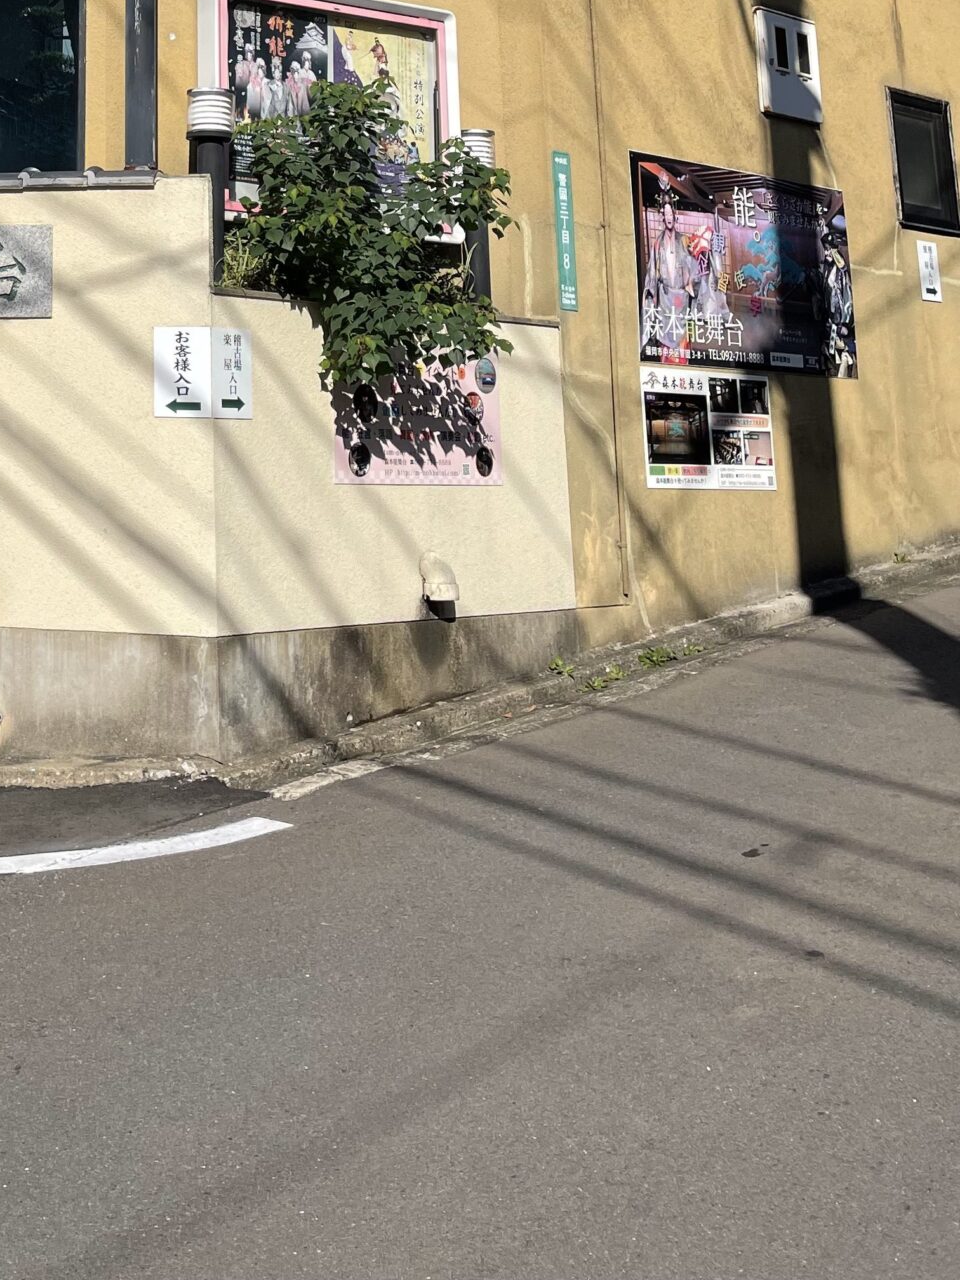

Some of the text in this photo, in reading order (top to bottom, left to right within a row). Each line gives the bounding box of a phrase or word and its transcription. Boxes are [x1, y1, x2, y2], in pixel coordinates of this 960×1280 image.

[413, 79, 425, 135] 特別公演
[563, 253, 571, 270] 8
[643, 304, 744, 348] 森本能舞台
[174, 330, 192, 396] お客様入口
[692, 350, 706, 360] 3-8-1
[229, 371, 238, 395] 入口
